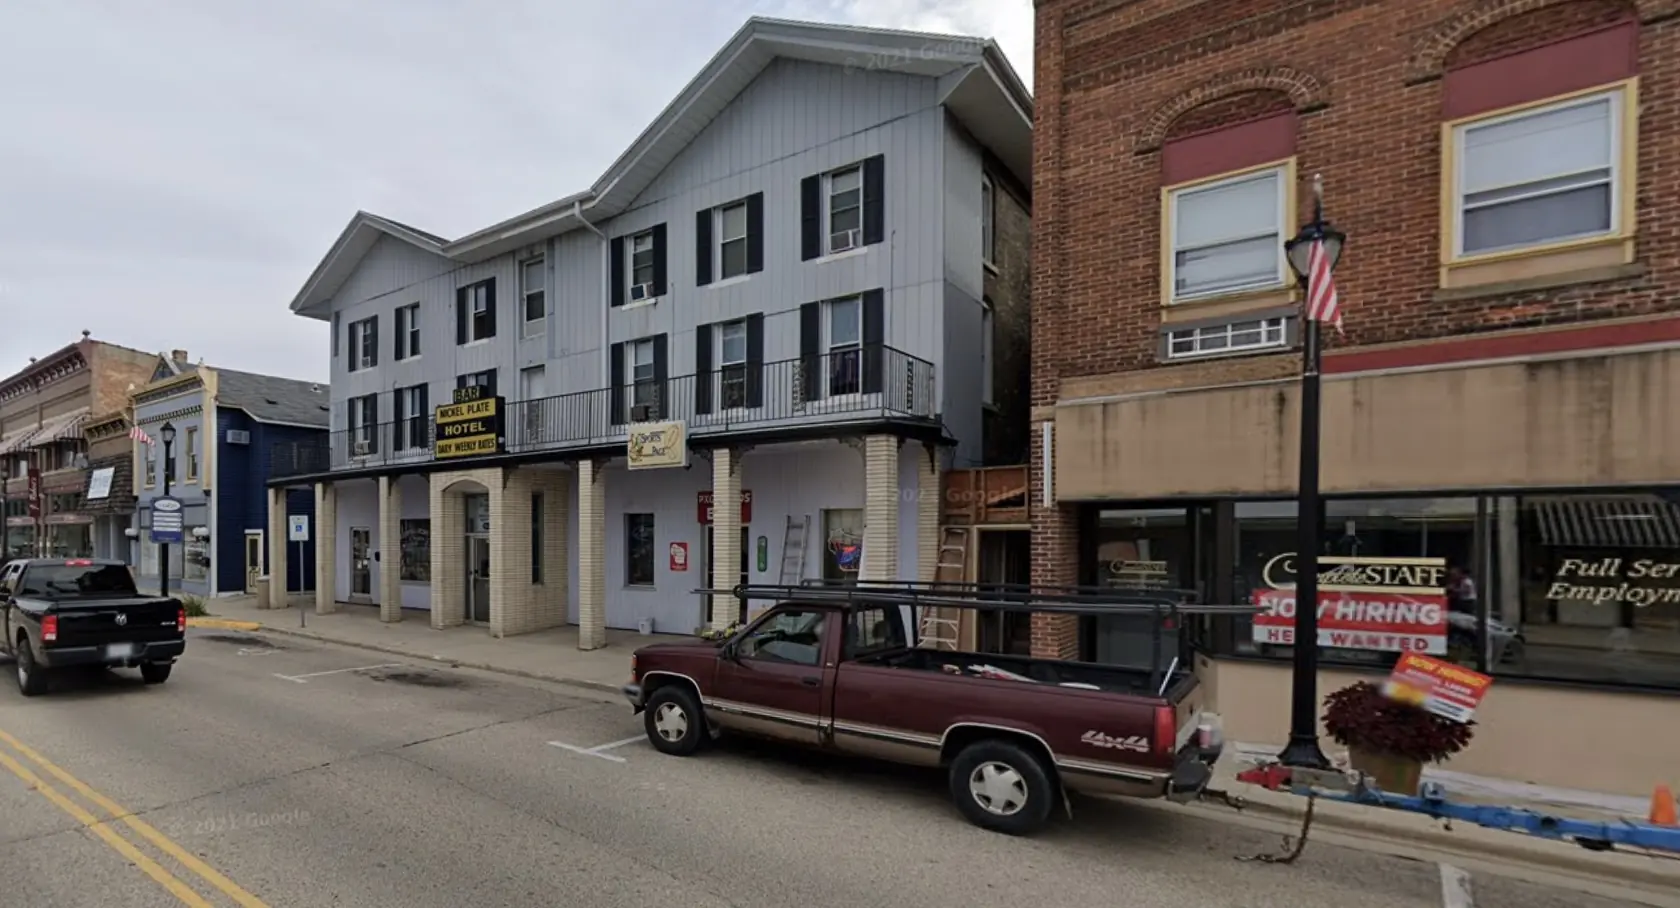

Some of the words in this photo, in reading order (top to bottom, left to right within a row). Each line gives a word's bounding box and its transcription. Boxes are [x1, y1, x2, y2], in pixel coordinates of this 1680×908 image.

[454, 387, 480, 402] BAR
[440, 405, 465, 418] NICKEL
[467, 401, 490, 415] PLATE
[445, 421, 486, 436] HOTEL
[1556, 558, 1623, 577] Full
[1334, 599, 1442, 625] HIRING
[1329, 631, 1430, 652] WANTED
